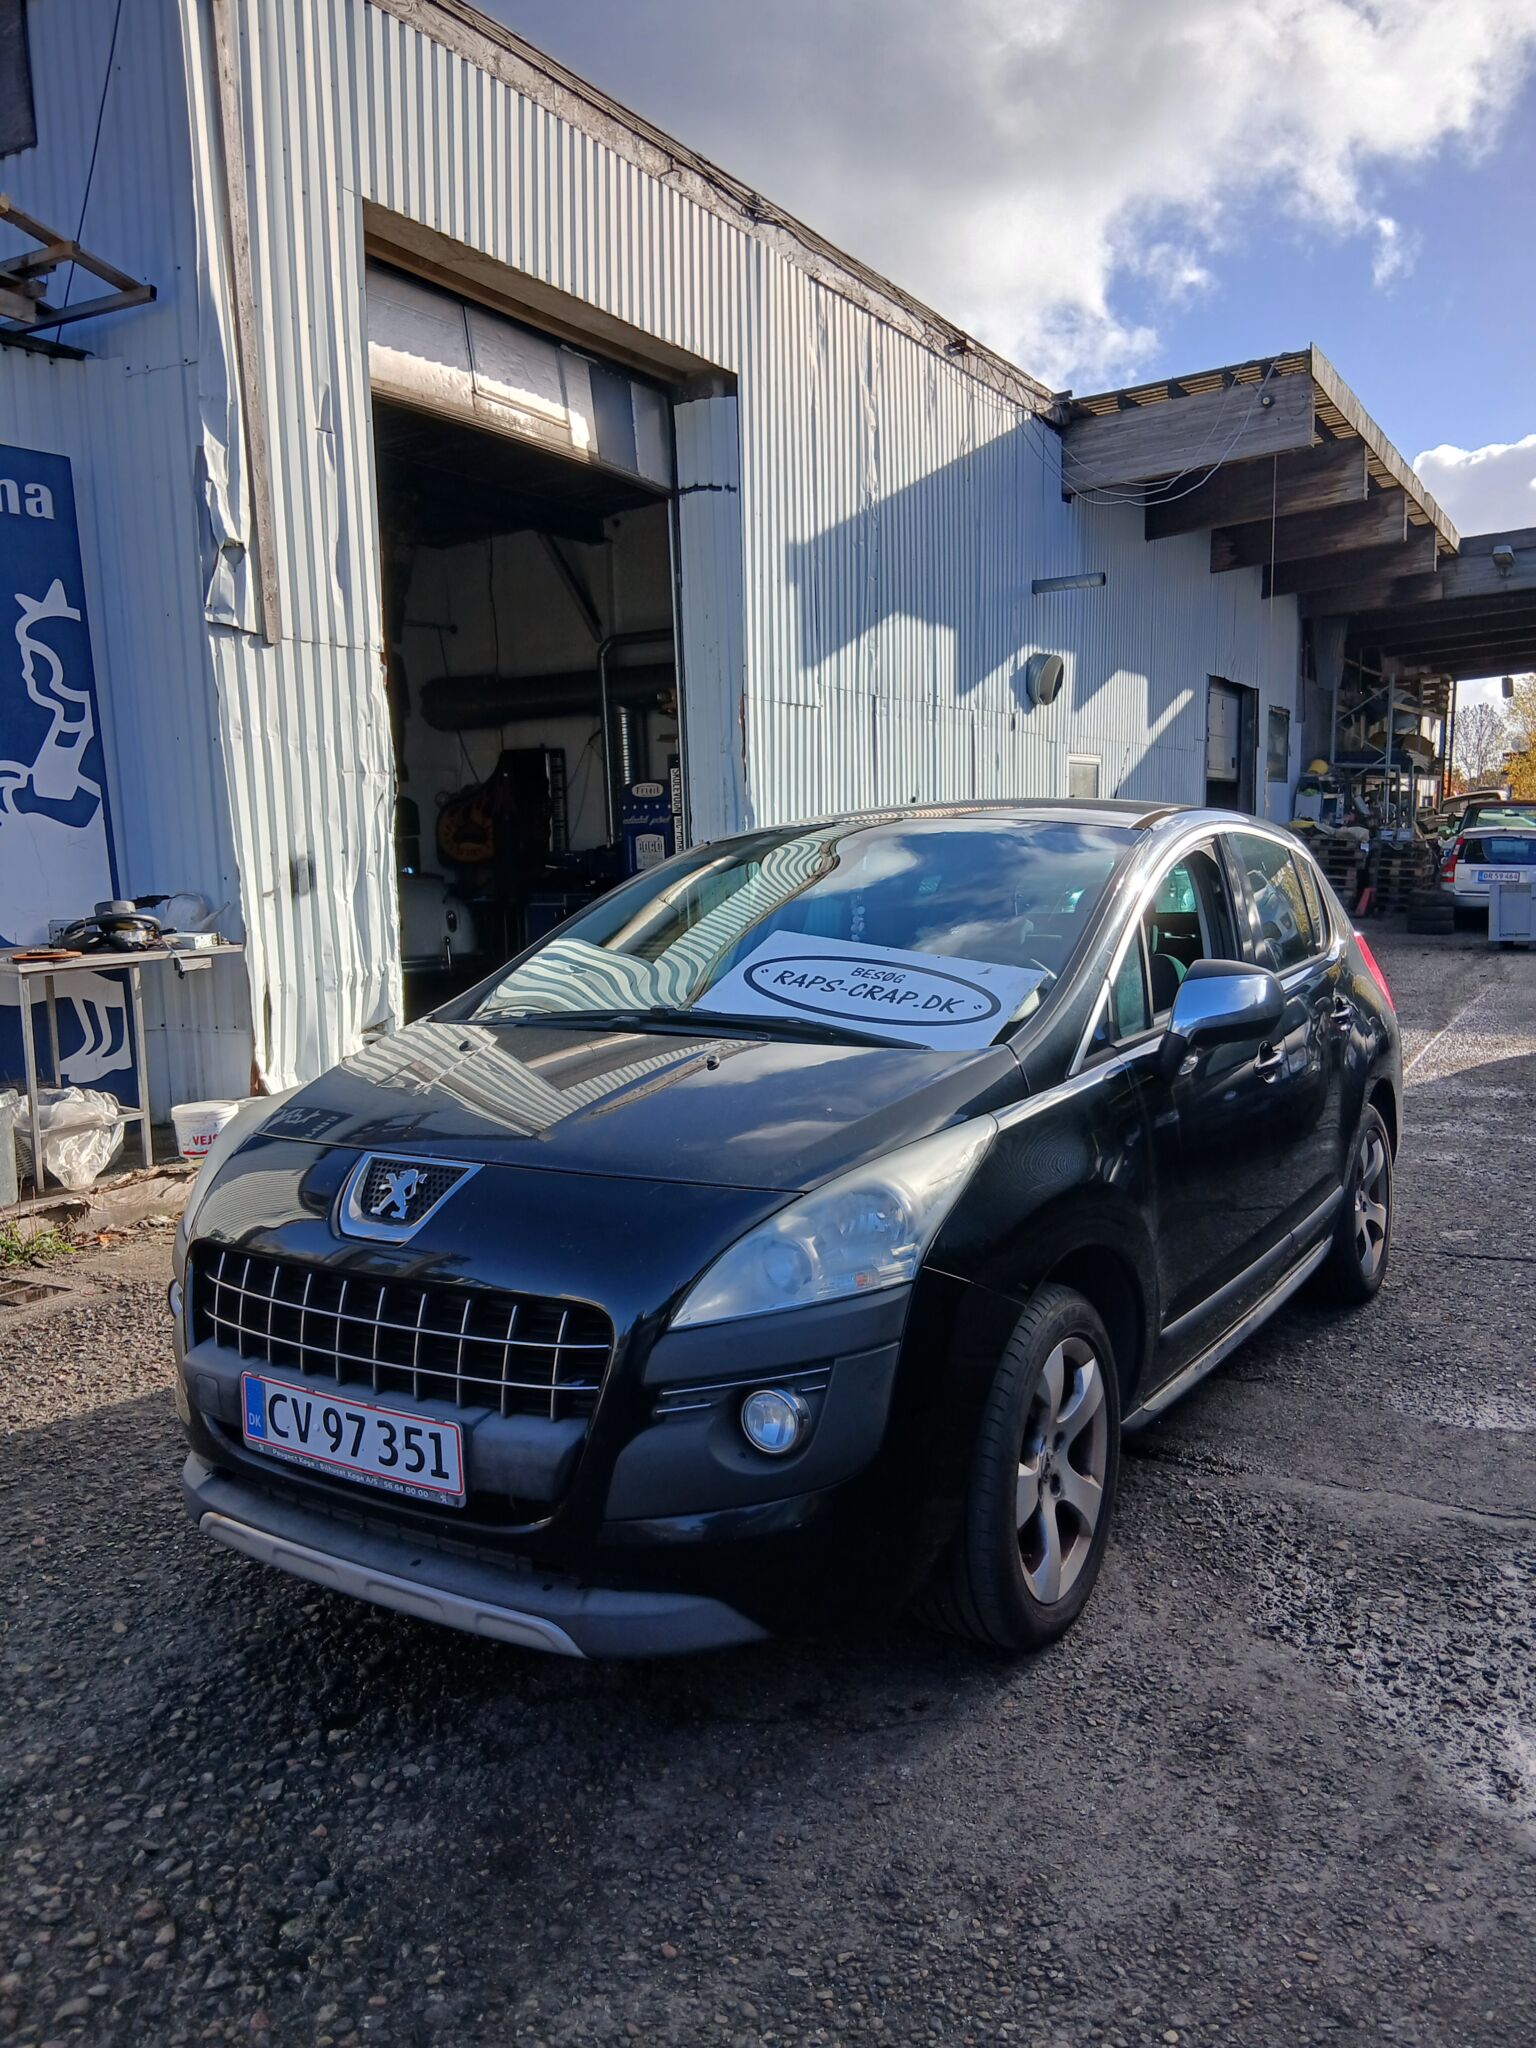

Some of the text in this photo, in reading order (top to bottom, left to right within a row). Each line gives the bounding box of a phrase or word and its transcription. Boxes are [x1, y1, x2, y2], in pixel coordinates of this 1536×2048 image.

[850, 967, 906, 985] BESØG
[772, 969, 965, 1014] RAPS-CRAP.DK
[248, 1412, 262, 1428] DK
[268, 1393, 450, 1480] CV 97 351
[405, 1486, 416, 1495] 00
[418, 1489, 429, 1498] 00
